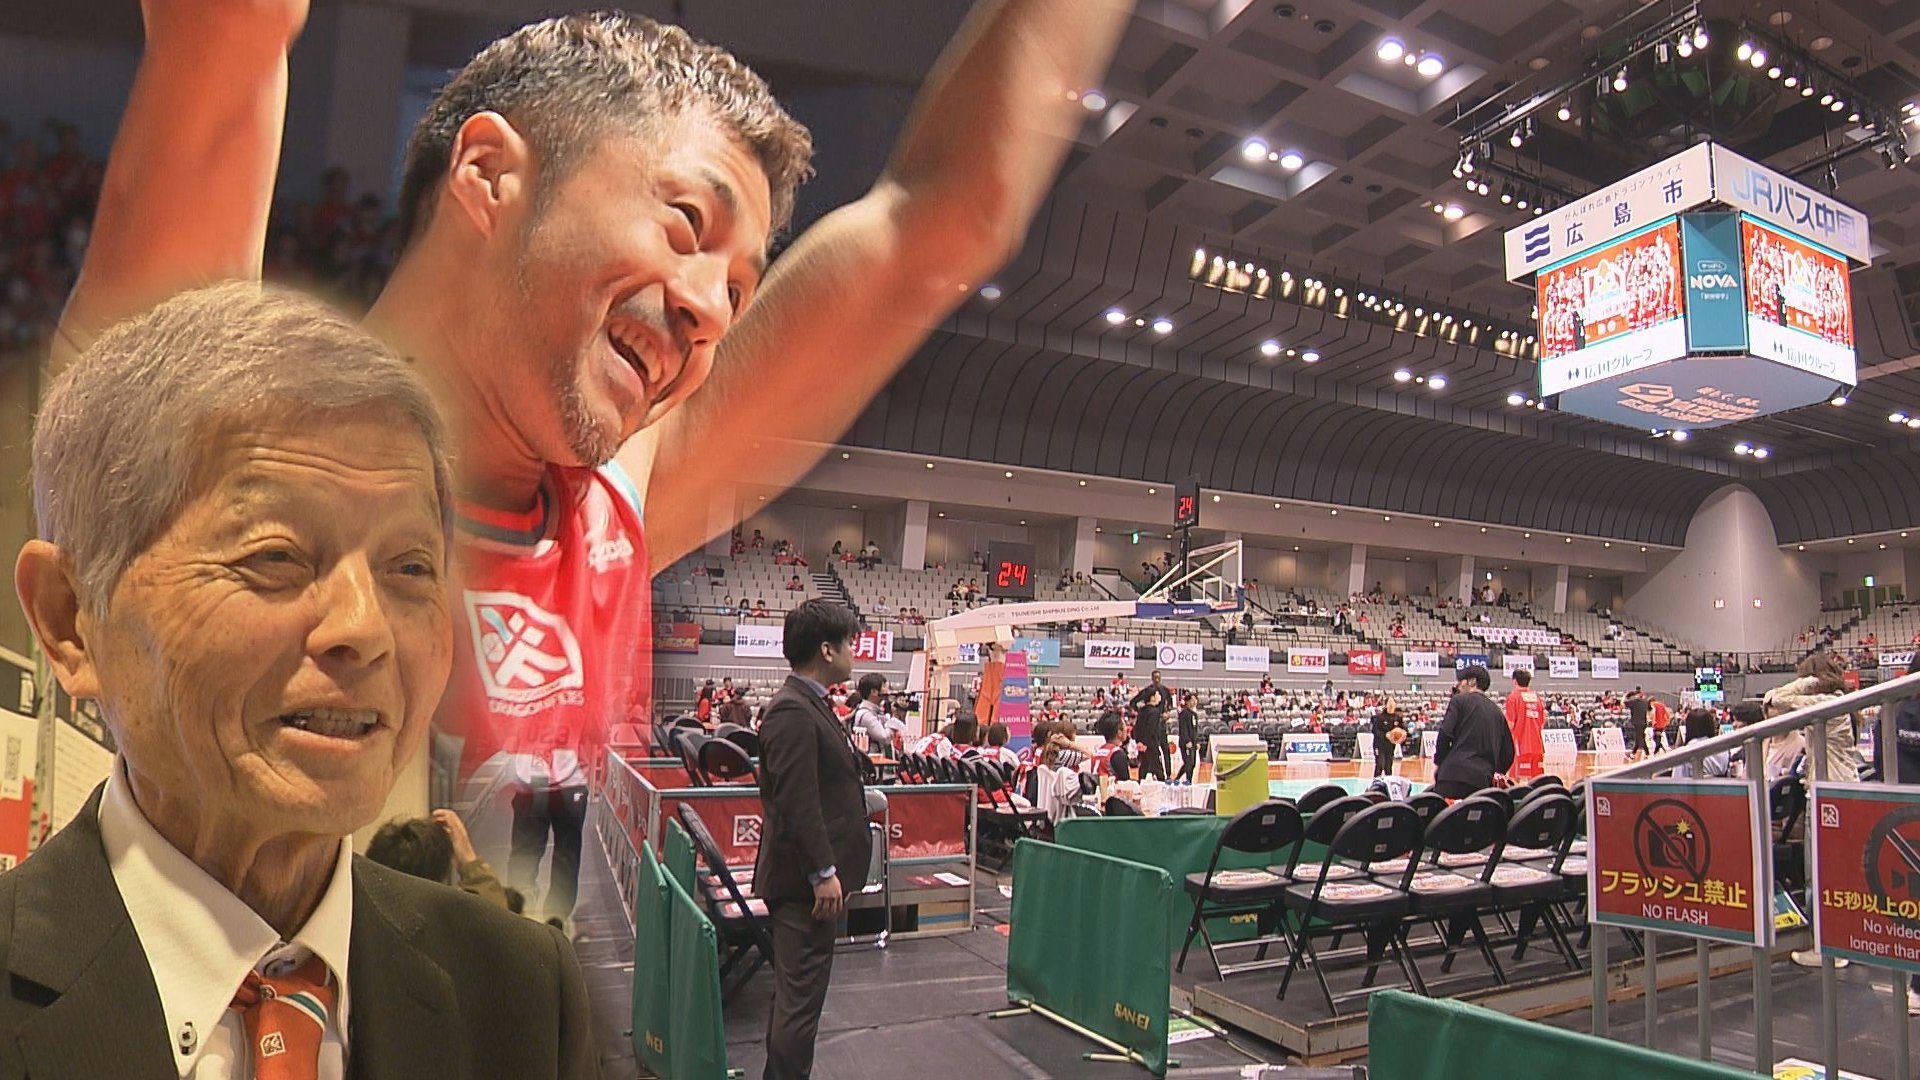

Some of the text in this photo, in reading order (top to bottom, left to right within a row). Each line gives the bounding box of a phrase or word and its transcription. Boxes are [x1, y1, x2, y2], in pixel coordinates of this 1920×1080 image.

[1565, 179, 1683, 248] 広島市
[1731, 167, 1857, 249] JRバス中国
[1690, 274, 1738, 290] NOVA
[1178, 496, 1193, 519] 24
[998, 561, 1028, 587] 24
[1178, 653, 1198, 662] RCC
[1601, 870, 1748, 909] フラッシュ禁止
[1642, 903, 1708, 925] NO FLASH
[1823, 889, 1920, 920] 15秒以上の
[1863, 918, 1882, 933] No
[1850, 935, 1890, 956] longer
